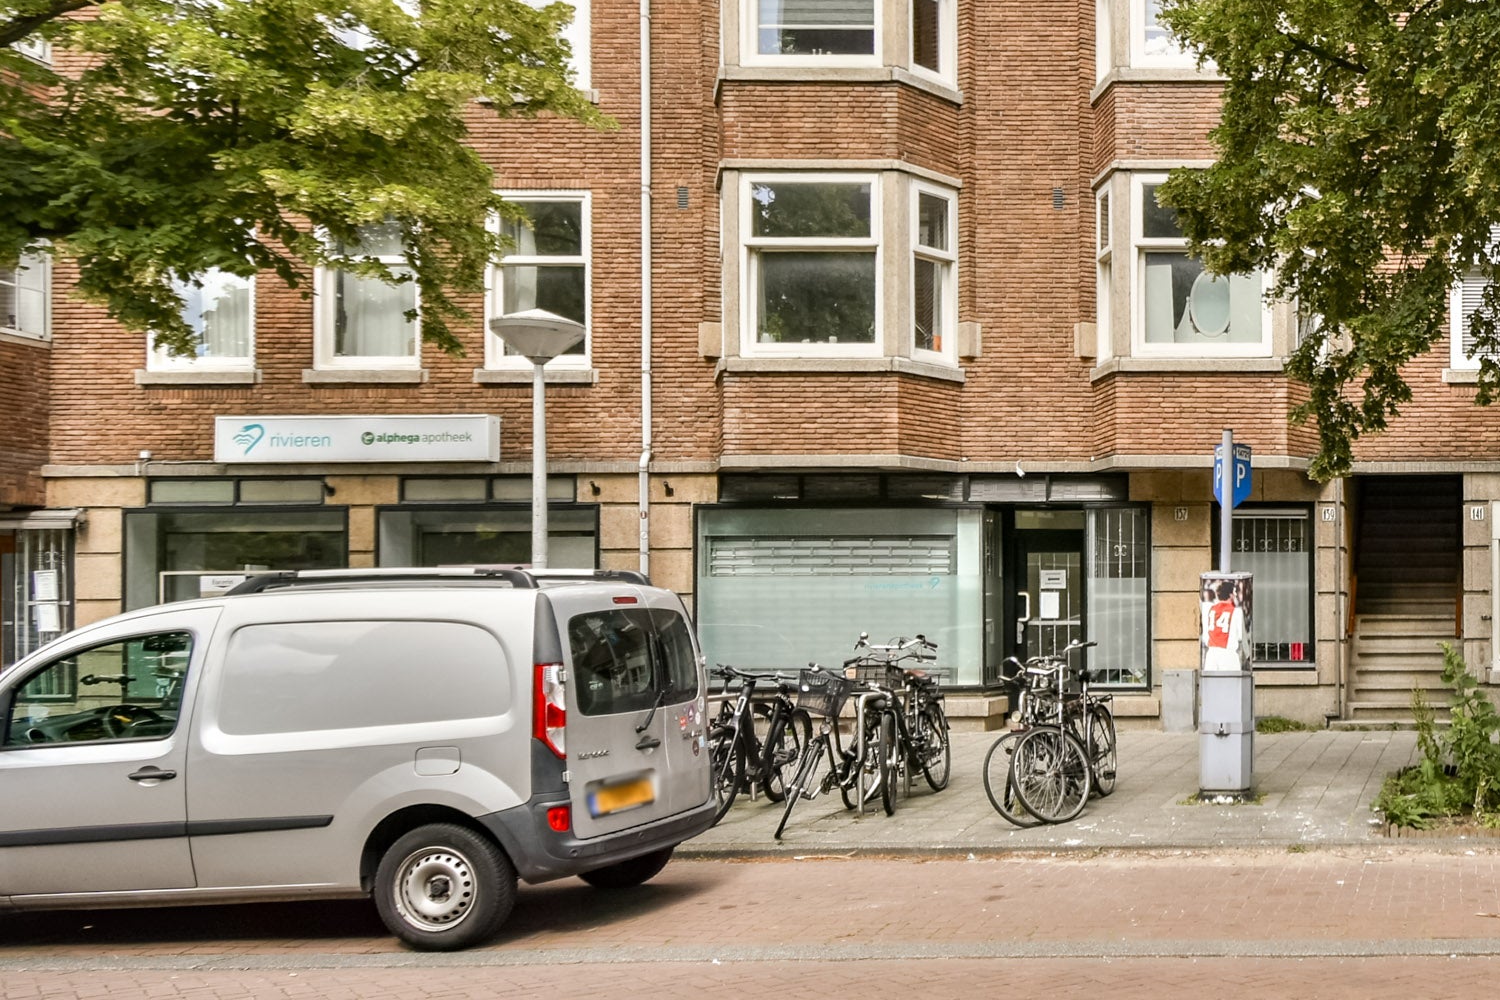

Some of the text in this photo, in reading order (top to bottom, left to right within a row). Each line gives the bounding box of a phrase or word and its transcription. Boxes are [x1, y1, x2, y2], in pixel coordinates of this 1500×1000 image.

[270, 433, 331, 448] rivieren
[376, 431, 472, 446] alphega apotheek
[1236, 463, 1246, 488] P
[1323, 508, 1335, 520] 139
[1472, 507, 1483, 520] 141
[1208, 609, 1231, 633] 14
